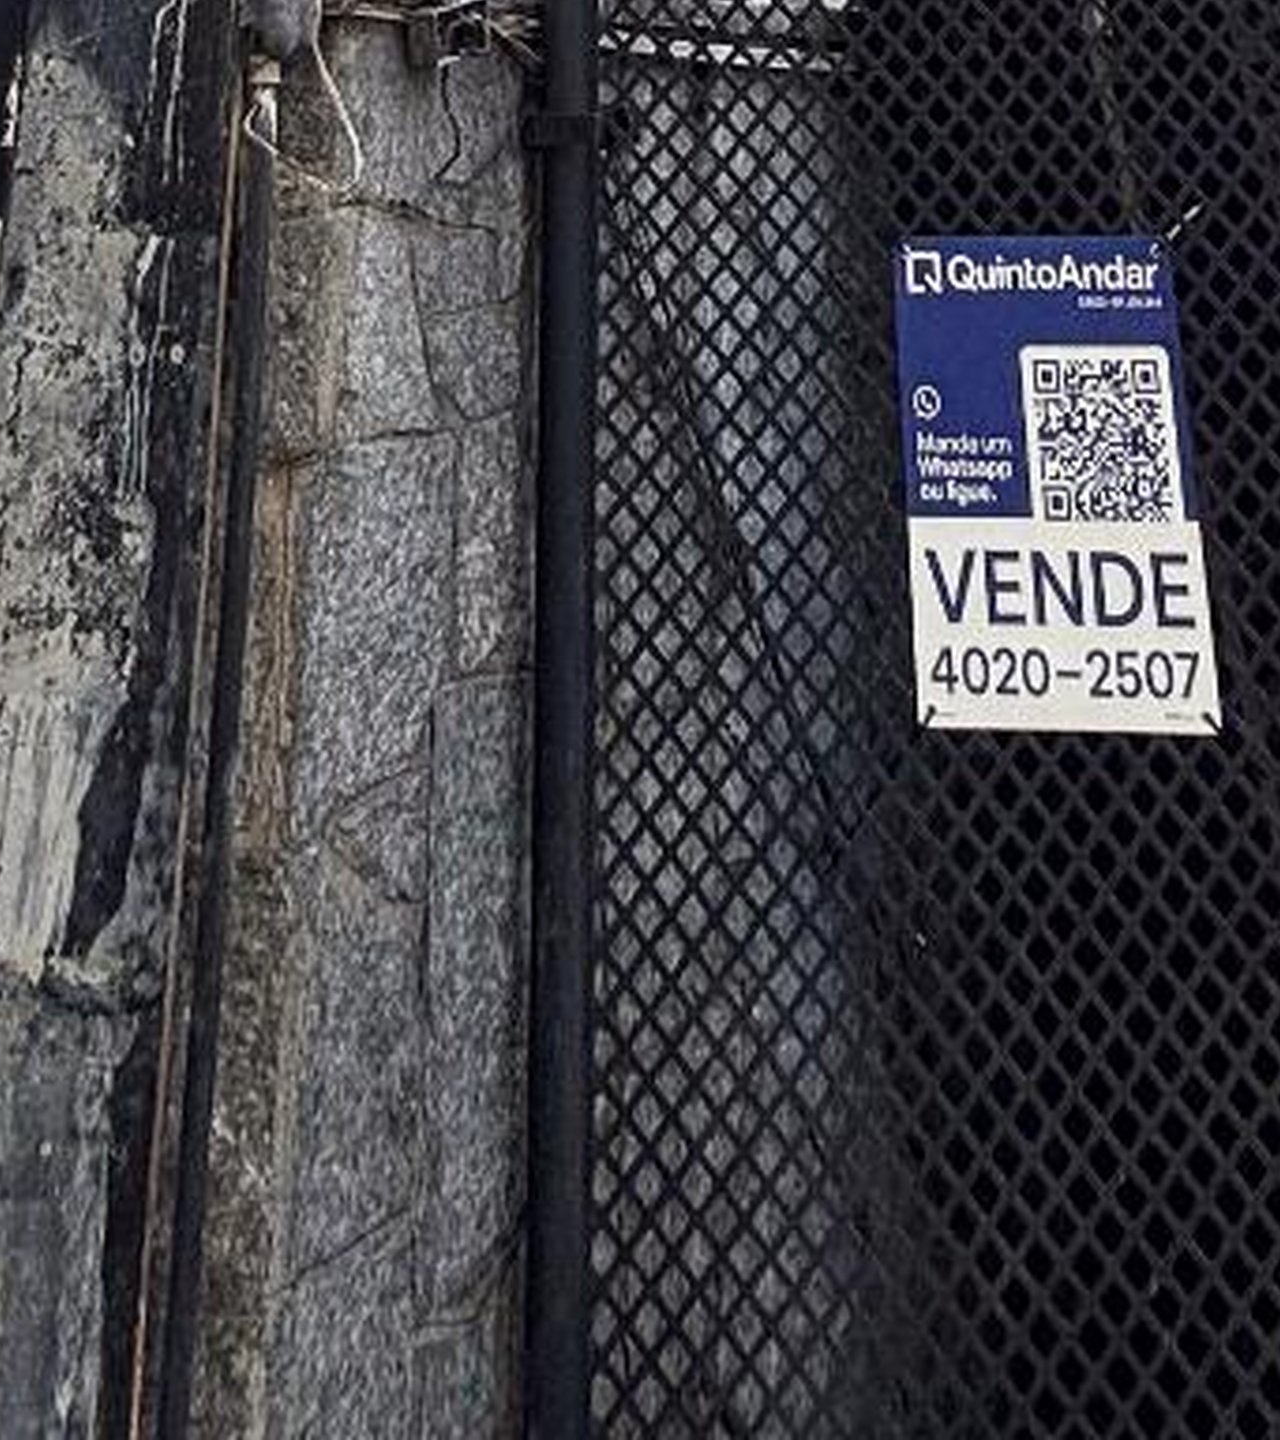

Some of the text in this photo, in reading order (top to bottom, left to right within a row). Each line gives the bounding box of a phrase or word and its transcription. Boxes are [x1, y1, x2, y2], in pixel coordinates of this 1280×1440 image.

[947, 255, 1158, 291] QuintoAndar
[924, 548, 1196, 628] VENDE
[931, 646, 1200, 698] 4020-2507
